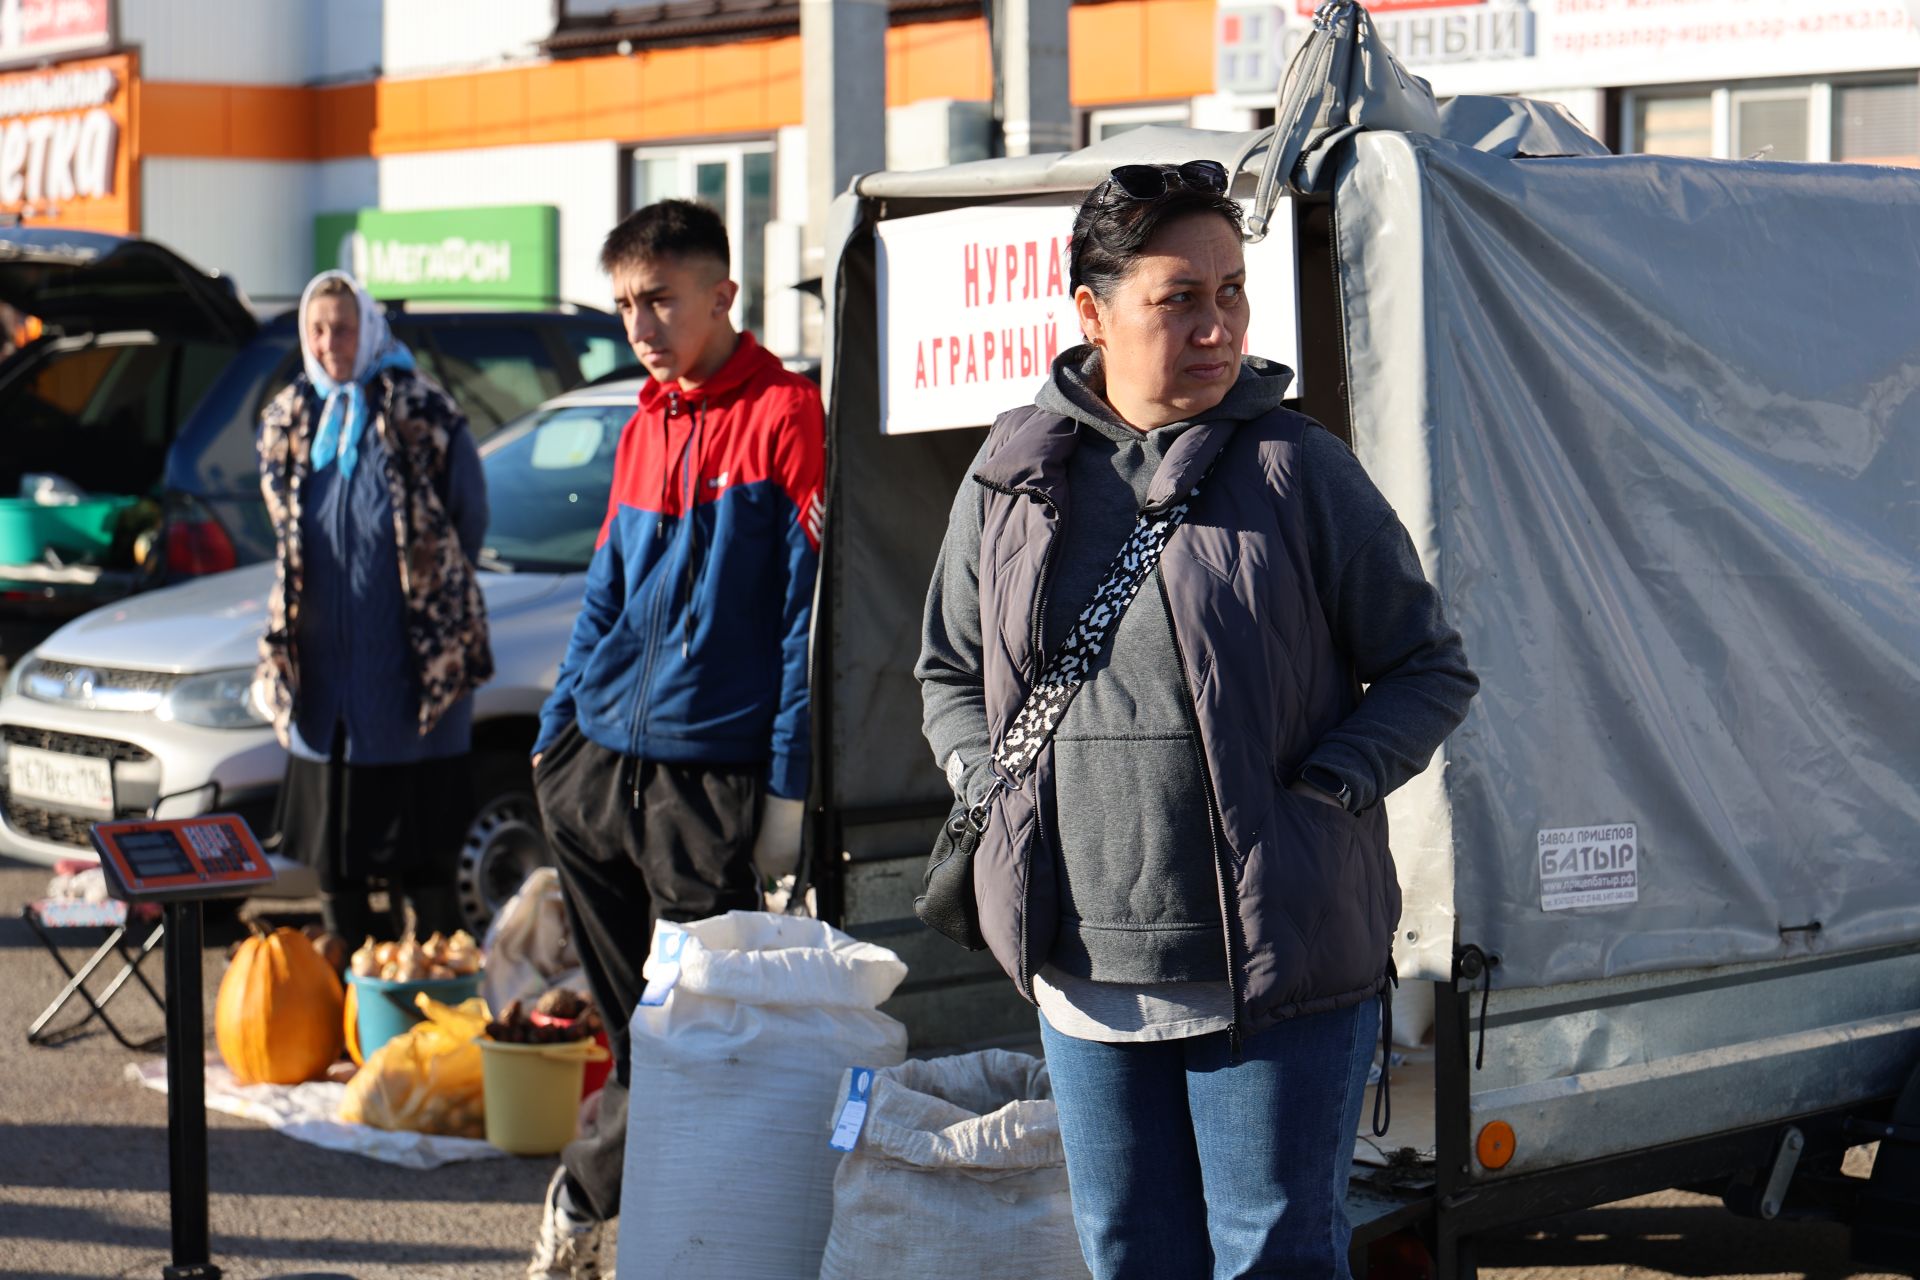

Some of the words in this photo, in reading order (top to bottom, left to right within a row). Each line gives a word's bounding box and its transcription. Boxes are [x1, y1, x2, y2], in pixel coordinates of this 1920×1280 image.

[915, 311, 1057, 389] АГРАРНЫЙ
[1540, 832, 1574, 846] ЗАВОД
[1577, 827, 1633, 844] ПРИЦЕПОВ
[1541, 843, 1634, 875] БАТЫР
